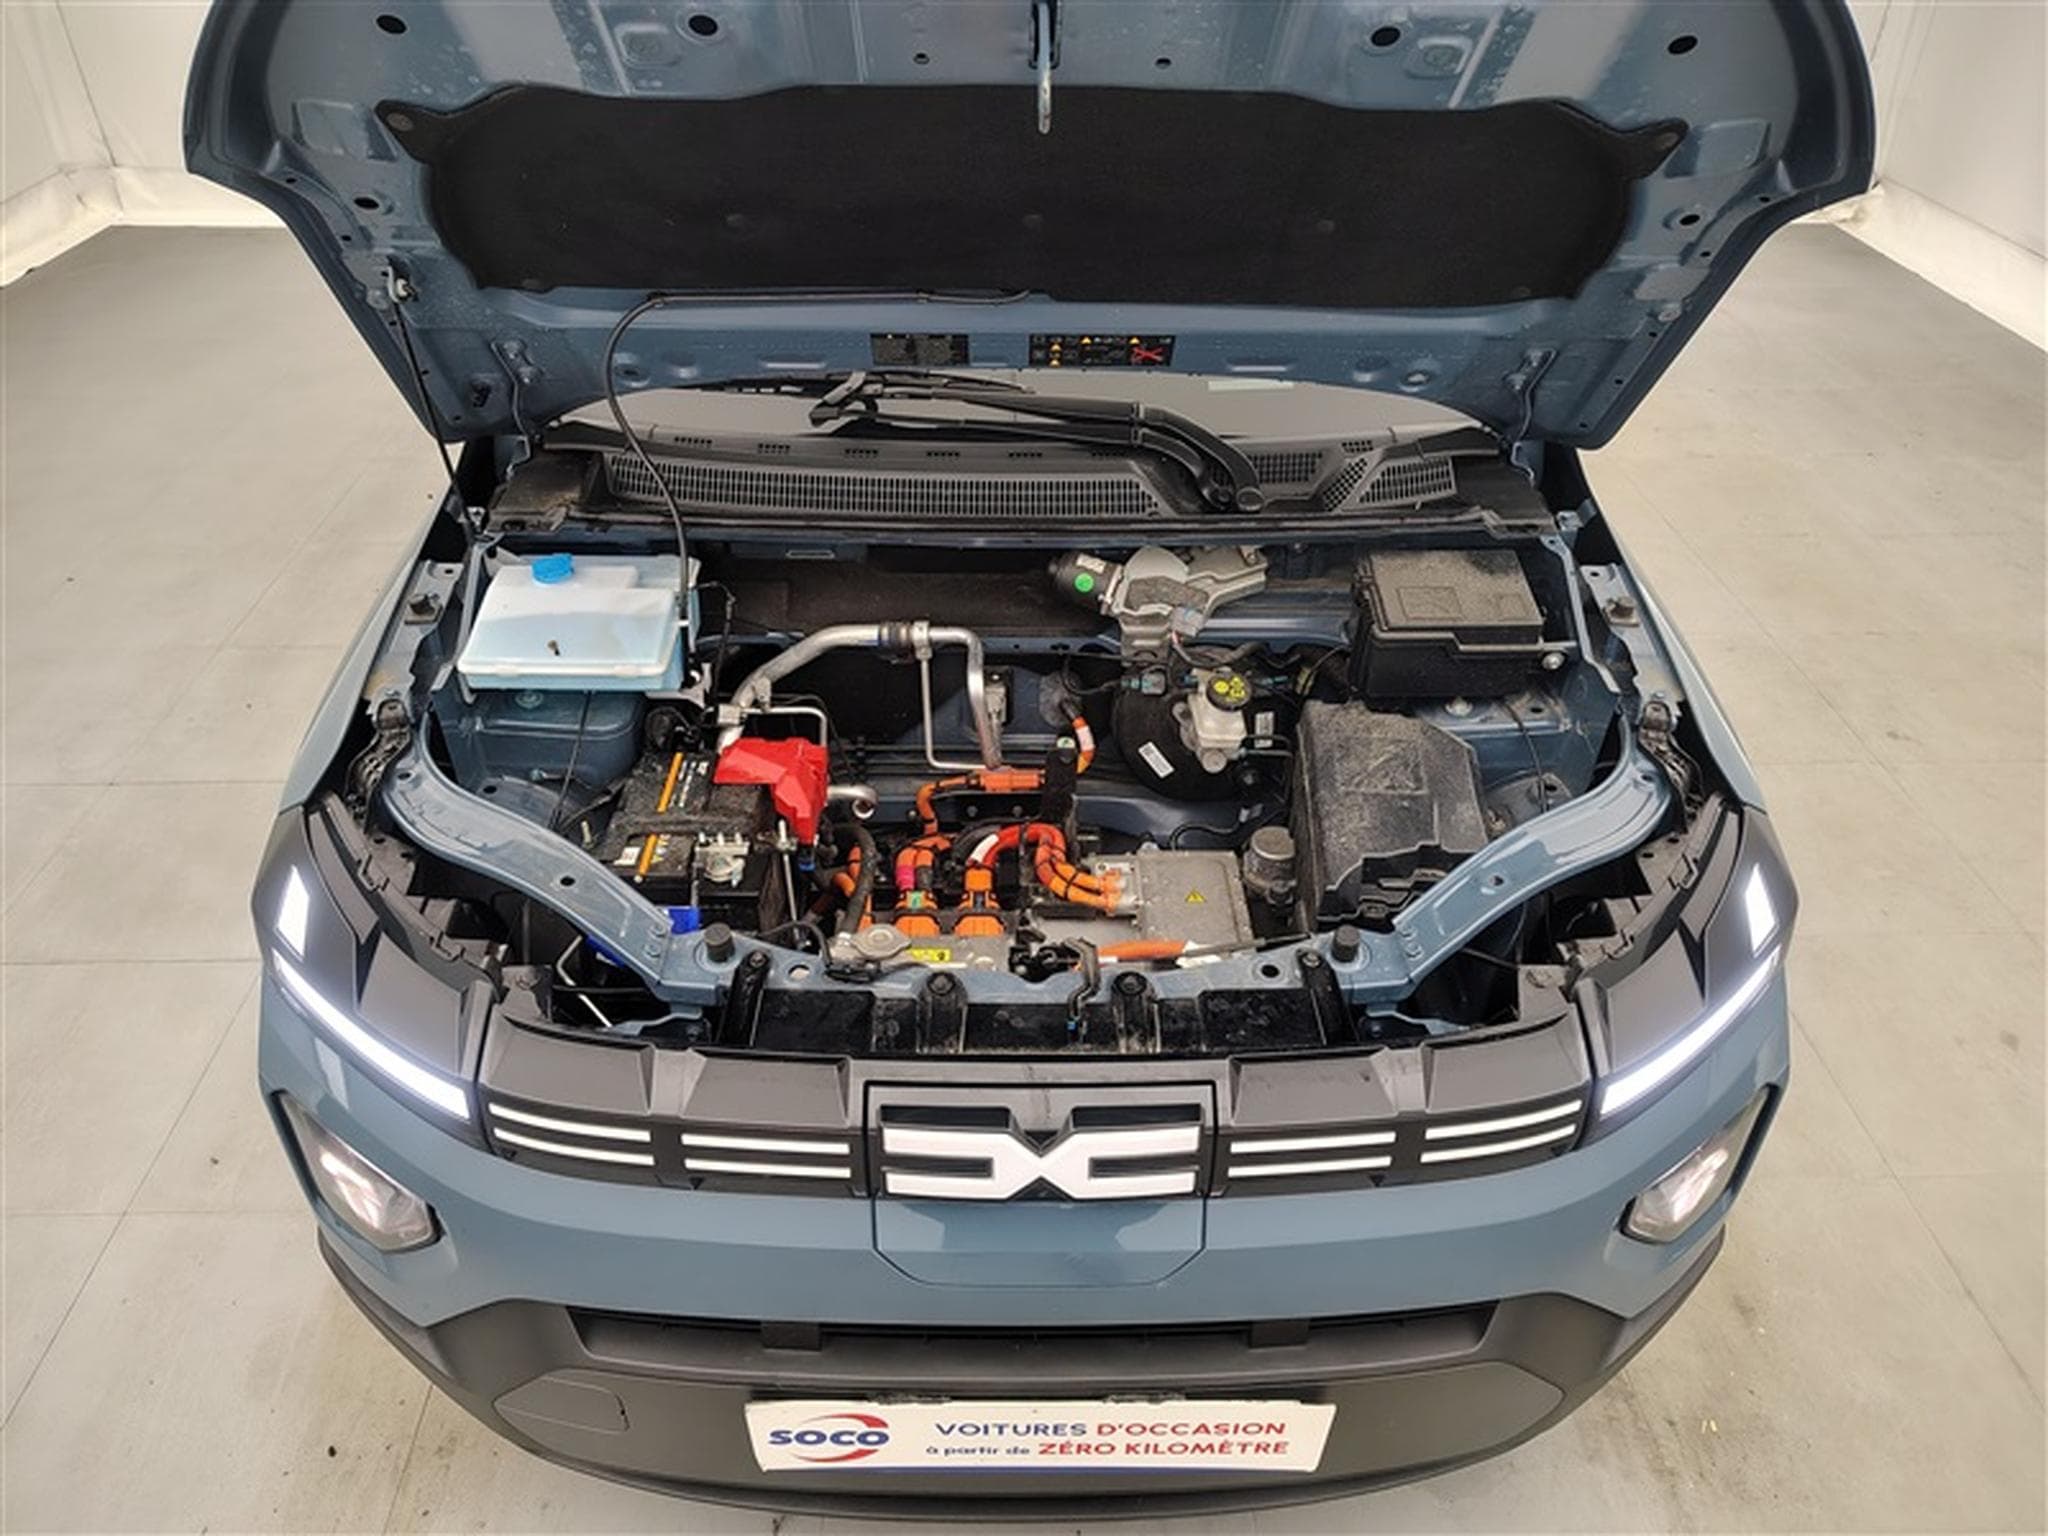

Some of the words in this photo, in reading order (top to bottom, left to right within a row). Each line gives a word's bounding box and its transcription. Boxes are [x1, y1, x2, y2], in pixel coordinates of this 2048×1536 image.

[769, 1427, 889, 1446] SOCO
[935, 1423, 1087, 1436] VOITURES
[1097, 1422, 1287, 1436] D'OCCASION
[944, 1446, 998, 1457] partir
[1005, 1446, 1030, 1455] de
[1038, 1440, 1116, 1455] ZÉRO
